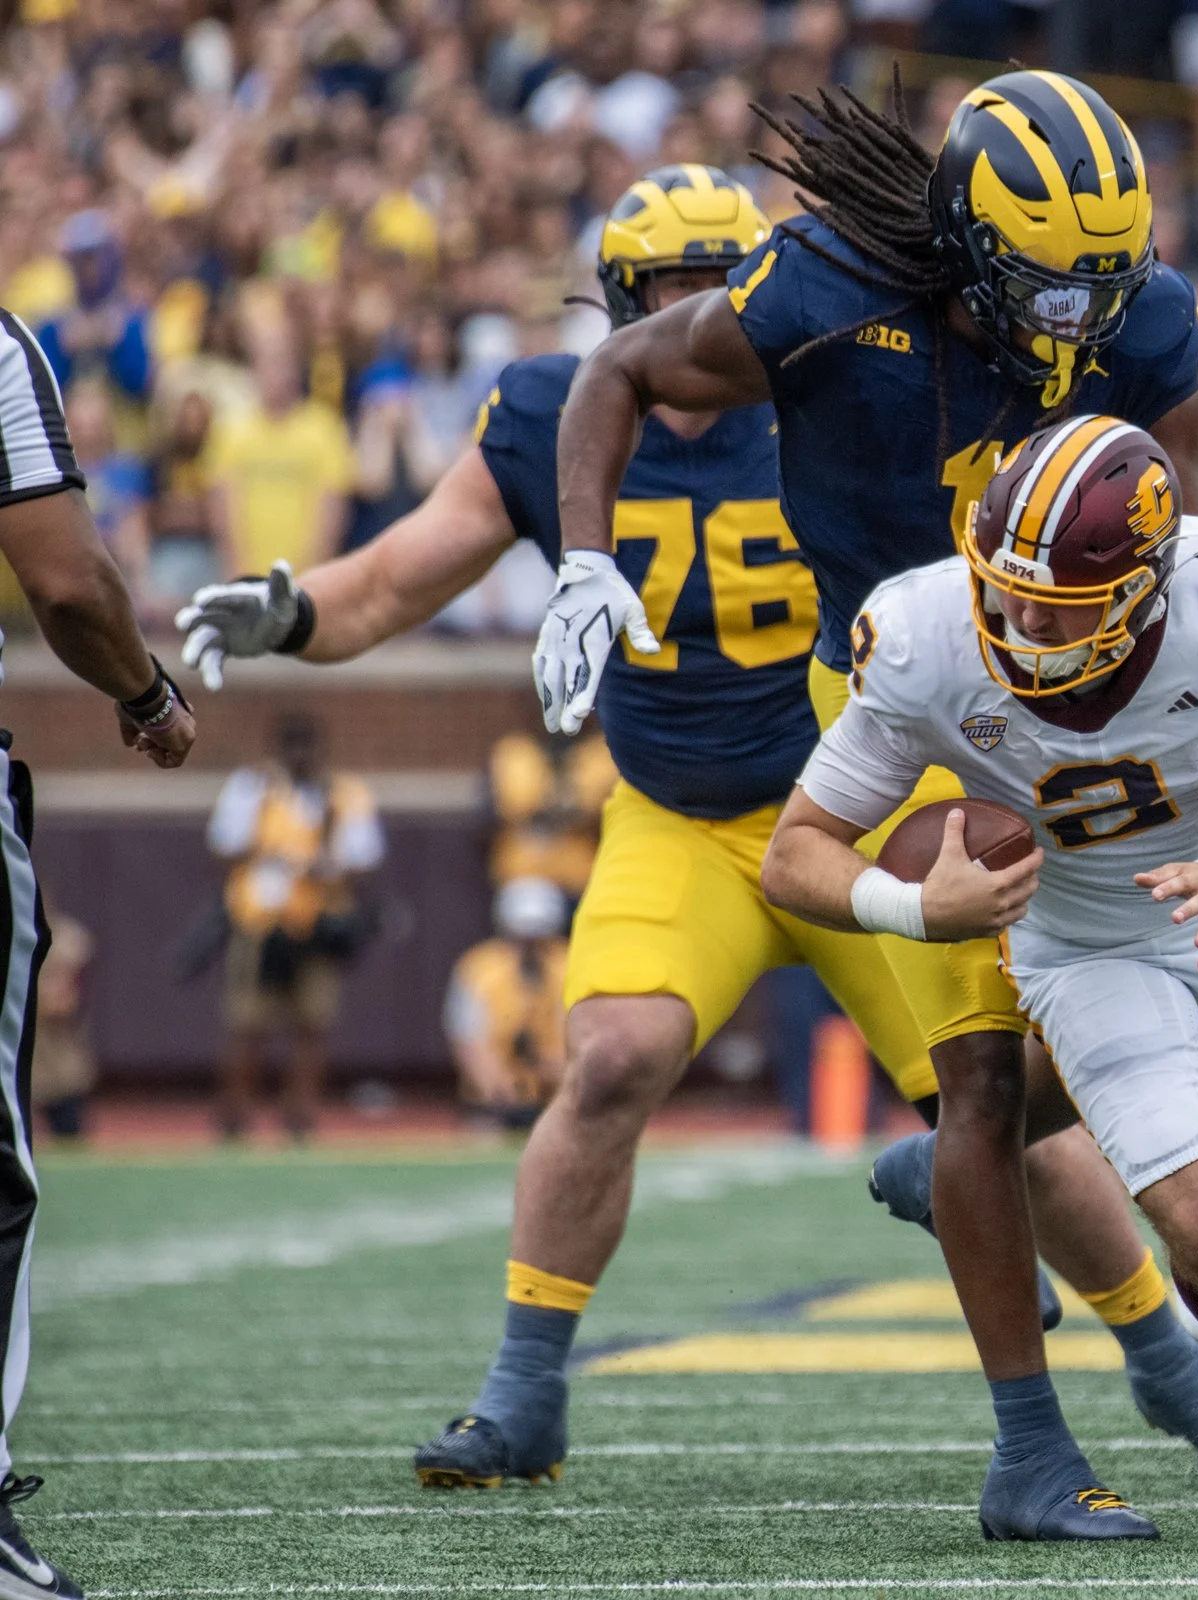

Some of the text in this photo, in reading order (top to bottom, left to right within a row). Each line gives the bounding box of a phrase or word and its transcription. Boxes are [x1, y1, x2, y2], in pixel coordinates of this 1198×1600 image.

[729, 249, 778, 315] 1
[1097, 257, 1117, 273] M
[612, 496, 820, 671] 76
[1002, 559, 1036, 581] 1974
[965, 725, 1005, 738] MAC
[1032, 754, 1183, 851] 2
